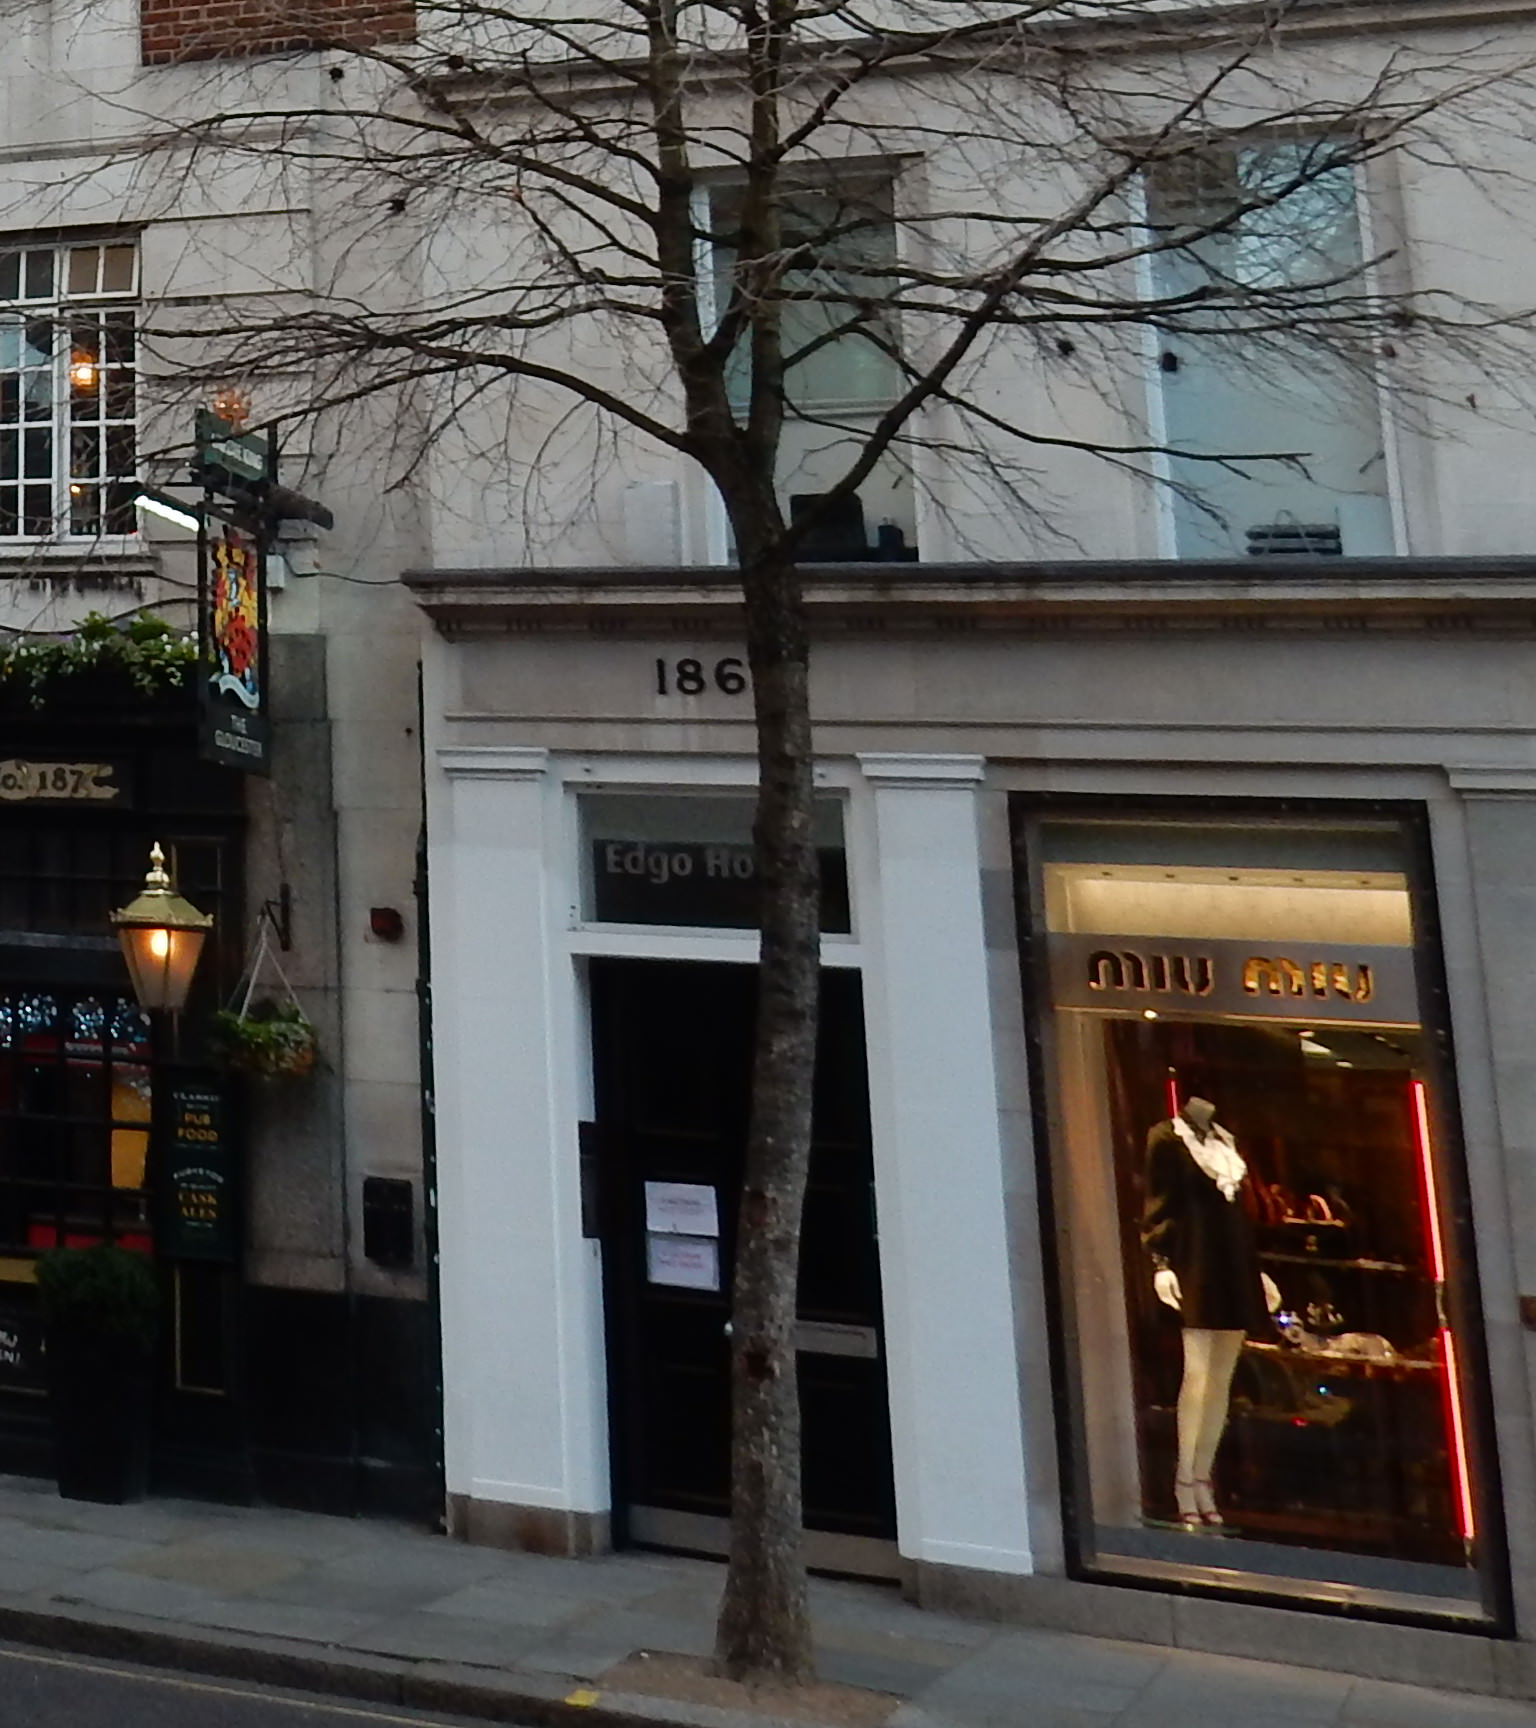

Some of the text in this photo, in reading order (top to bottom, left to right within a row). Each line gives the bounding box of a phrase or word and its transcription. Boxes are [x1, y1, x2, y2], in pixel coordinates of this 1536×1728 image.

[656, 658, 746, 696] 186
[38, 769, 86, 795] 187
[605, 842, 693, 884] Edgo
[177, 1127, 219, 1141] FOOD
